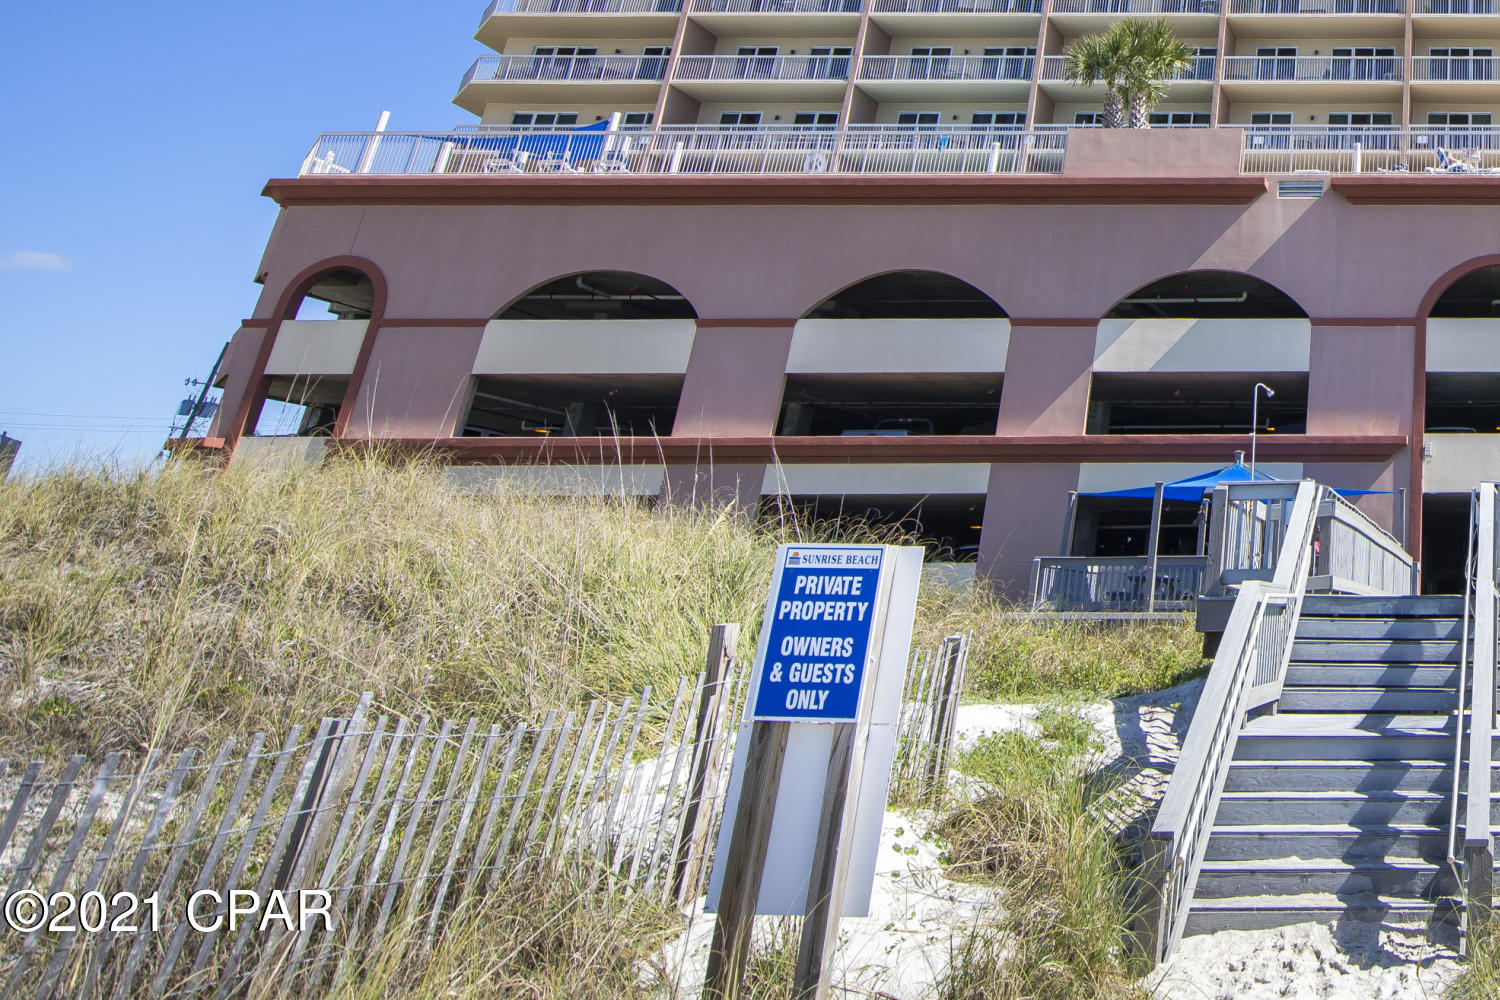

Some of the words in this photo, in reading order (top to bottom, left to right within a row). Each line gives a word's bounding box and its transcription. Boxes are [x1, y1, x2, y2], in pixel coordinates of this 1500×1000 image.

[802, 554, 843, 565] SUNRISE
[845, 555, 879, 565] BEACH
[793, 575, 863, 596] PRIVATE
[778, 600, 869, 621] PROPERTY
[780, 636, 854, 658] OWNERS
[769, 662, 782, 683] &
[789, 663, 855, 684] GUESTS
[785, 689, 830, 710] ONLY
